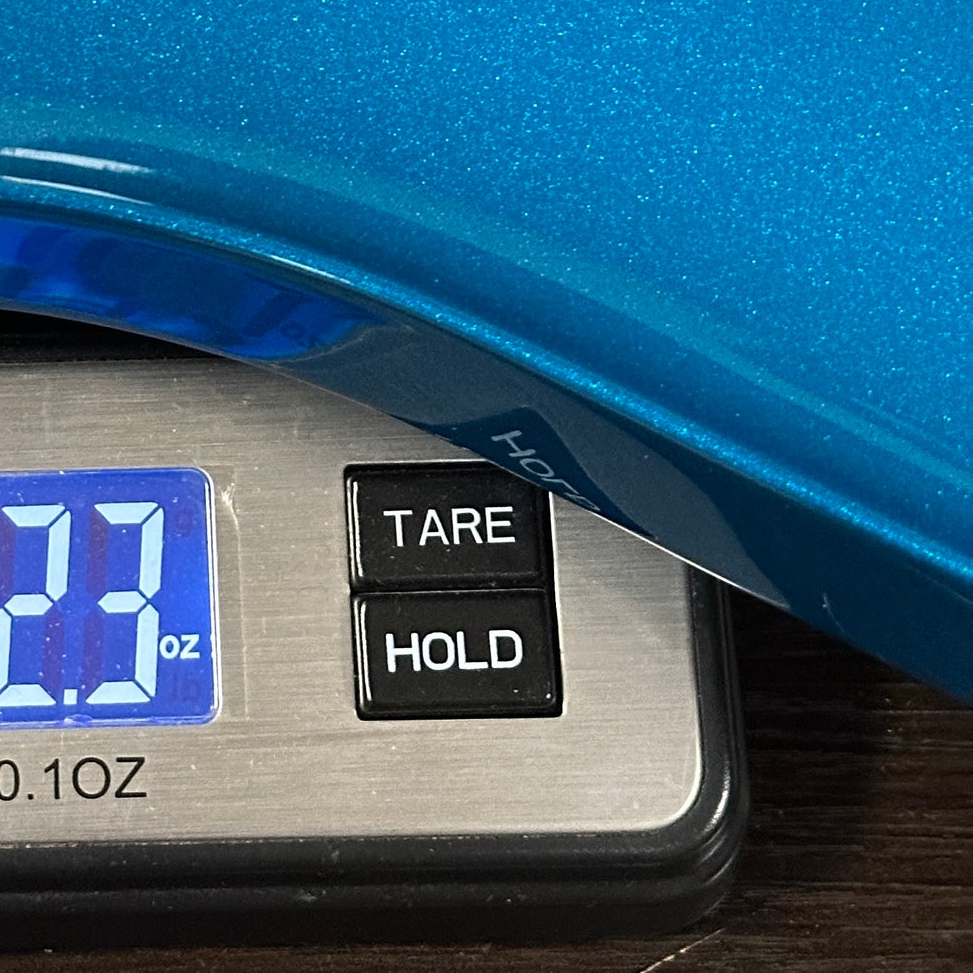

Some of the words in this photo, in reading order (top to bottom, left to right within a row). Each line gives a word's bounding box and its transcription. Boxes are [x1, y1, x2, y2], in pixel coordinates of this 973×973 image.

[383, 506, 516, 547] TARE
[159, 634, 200, 659] oz
[385, 629, 523, 673] HOLD
